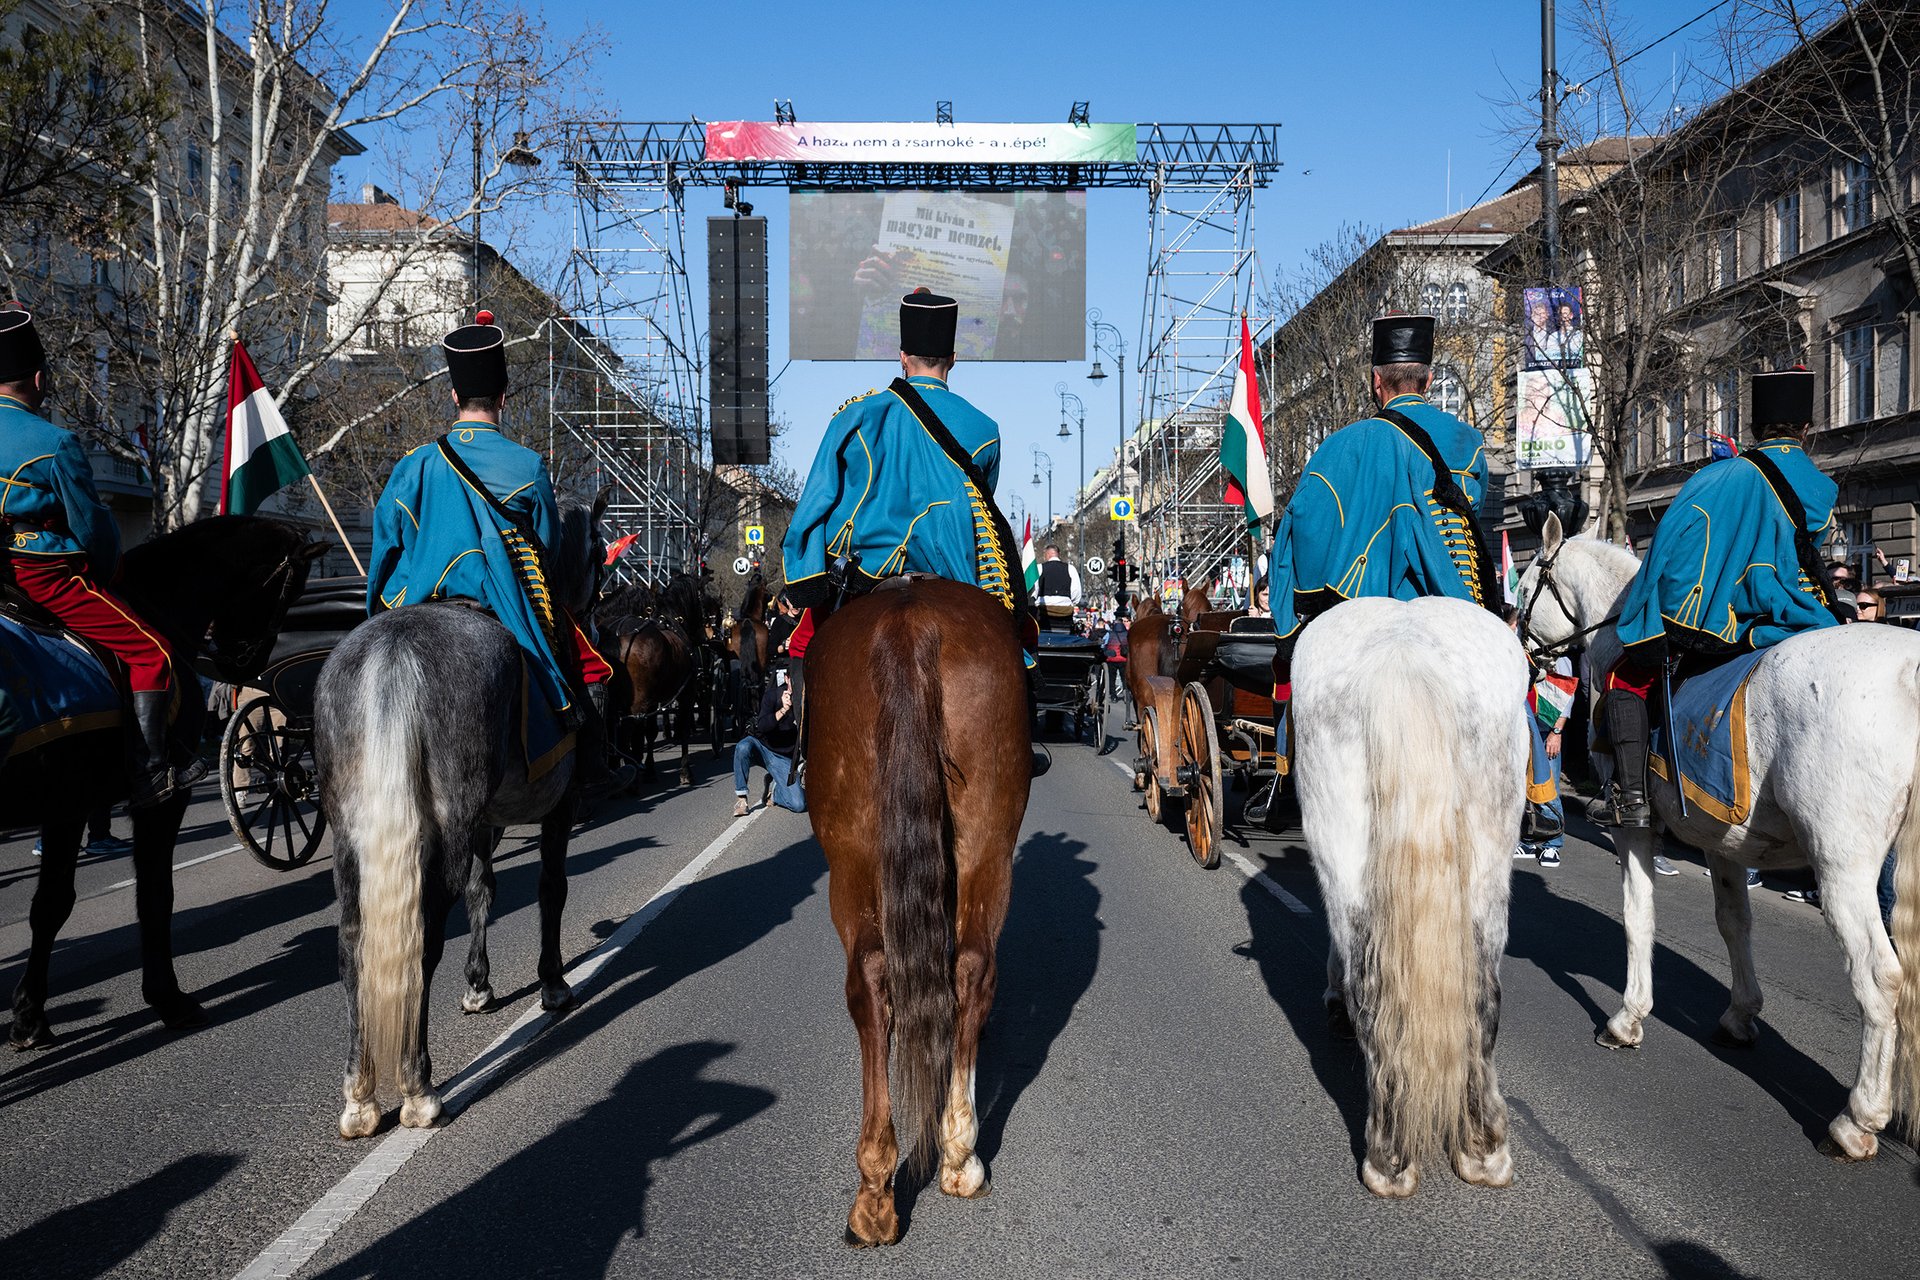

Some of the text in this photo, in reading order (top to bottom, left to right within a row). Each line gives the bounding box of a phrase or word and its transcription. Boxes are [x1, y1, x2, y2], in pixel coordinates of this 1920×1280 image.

[797, 136, 808, 147] A
[853, 139, 887, 147] nem
[892, 139, 901, 147] a
[990, 139, 998, 148] a
[1003, 136, 1046, 150] épé!
[916, 207, 934, 220] Mit
[968, 220, 975, 229] a
[886, 219, 1002, 251] magyar nemzet.
